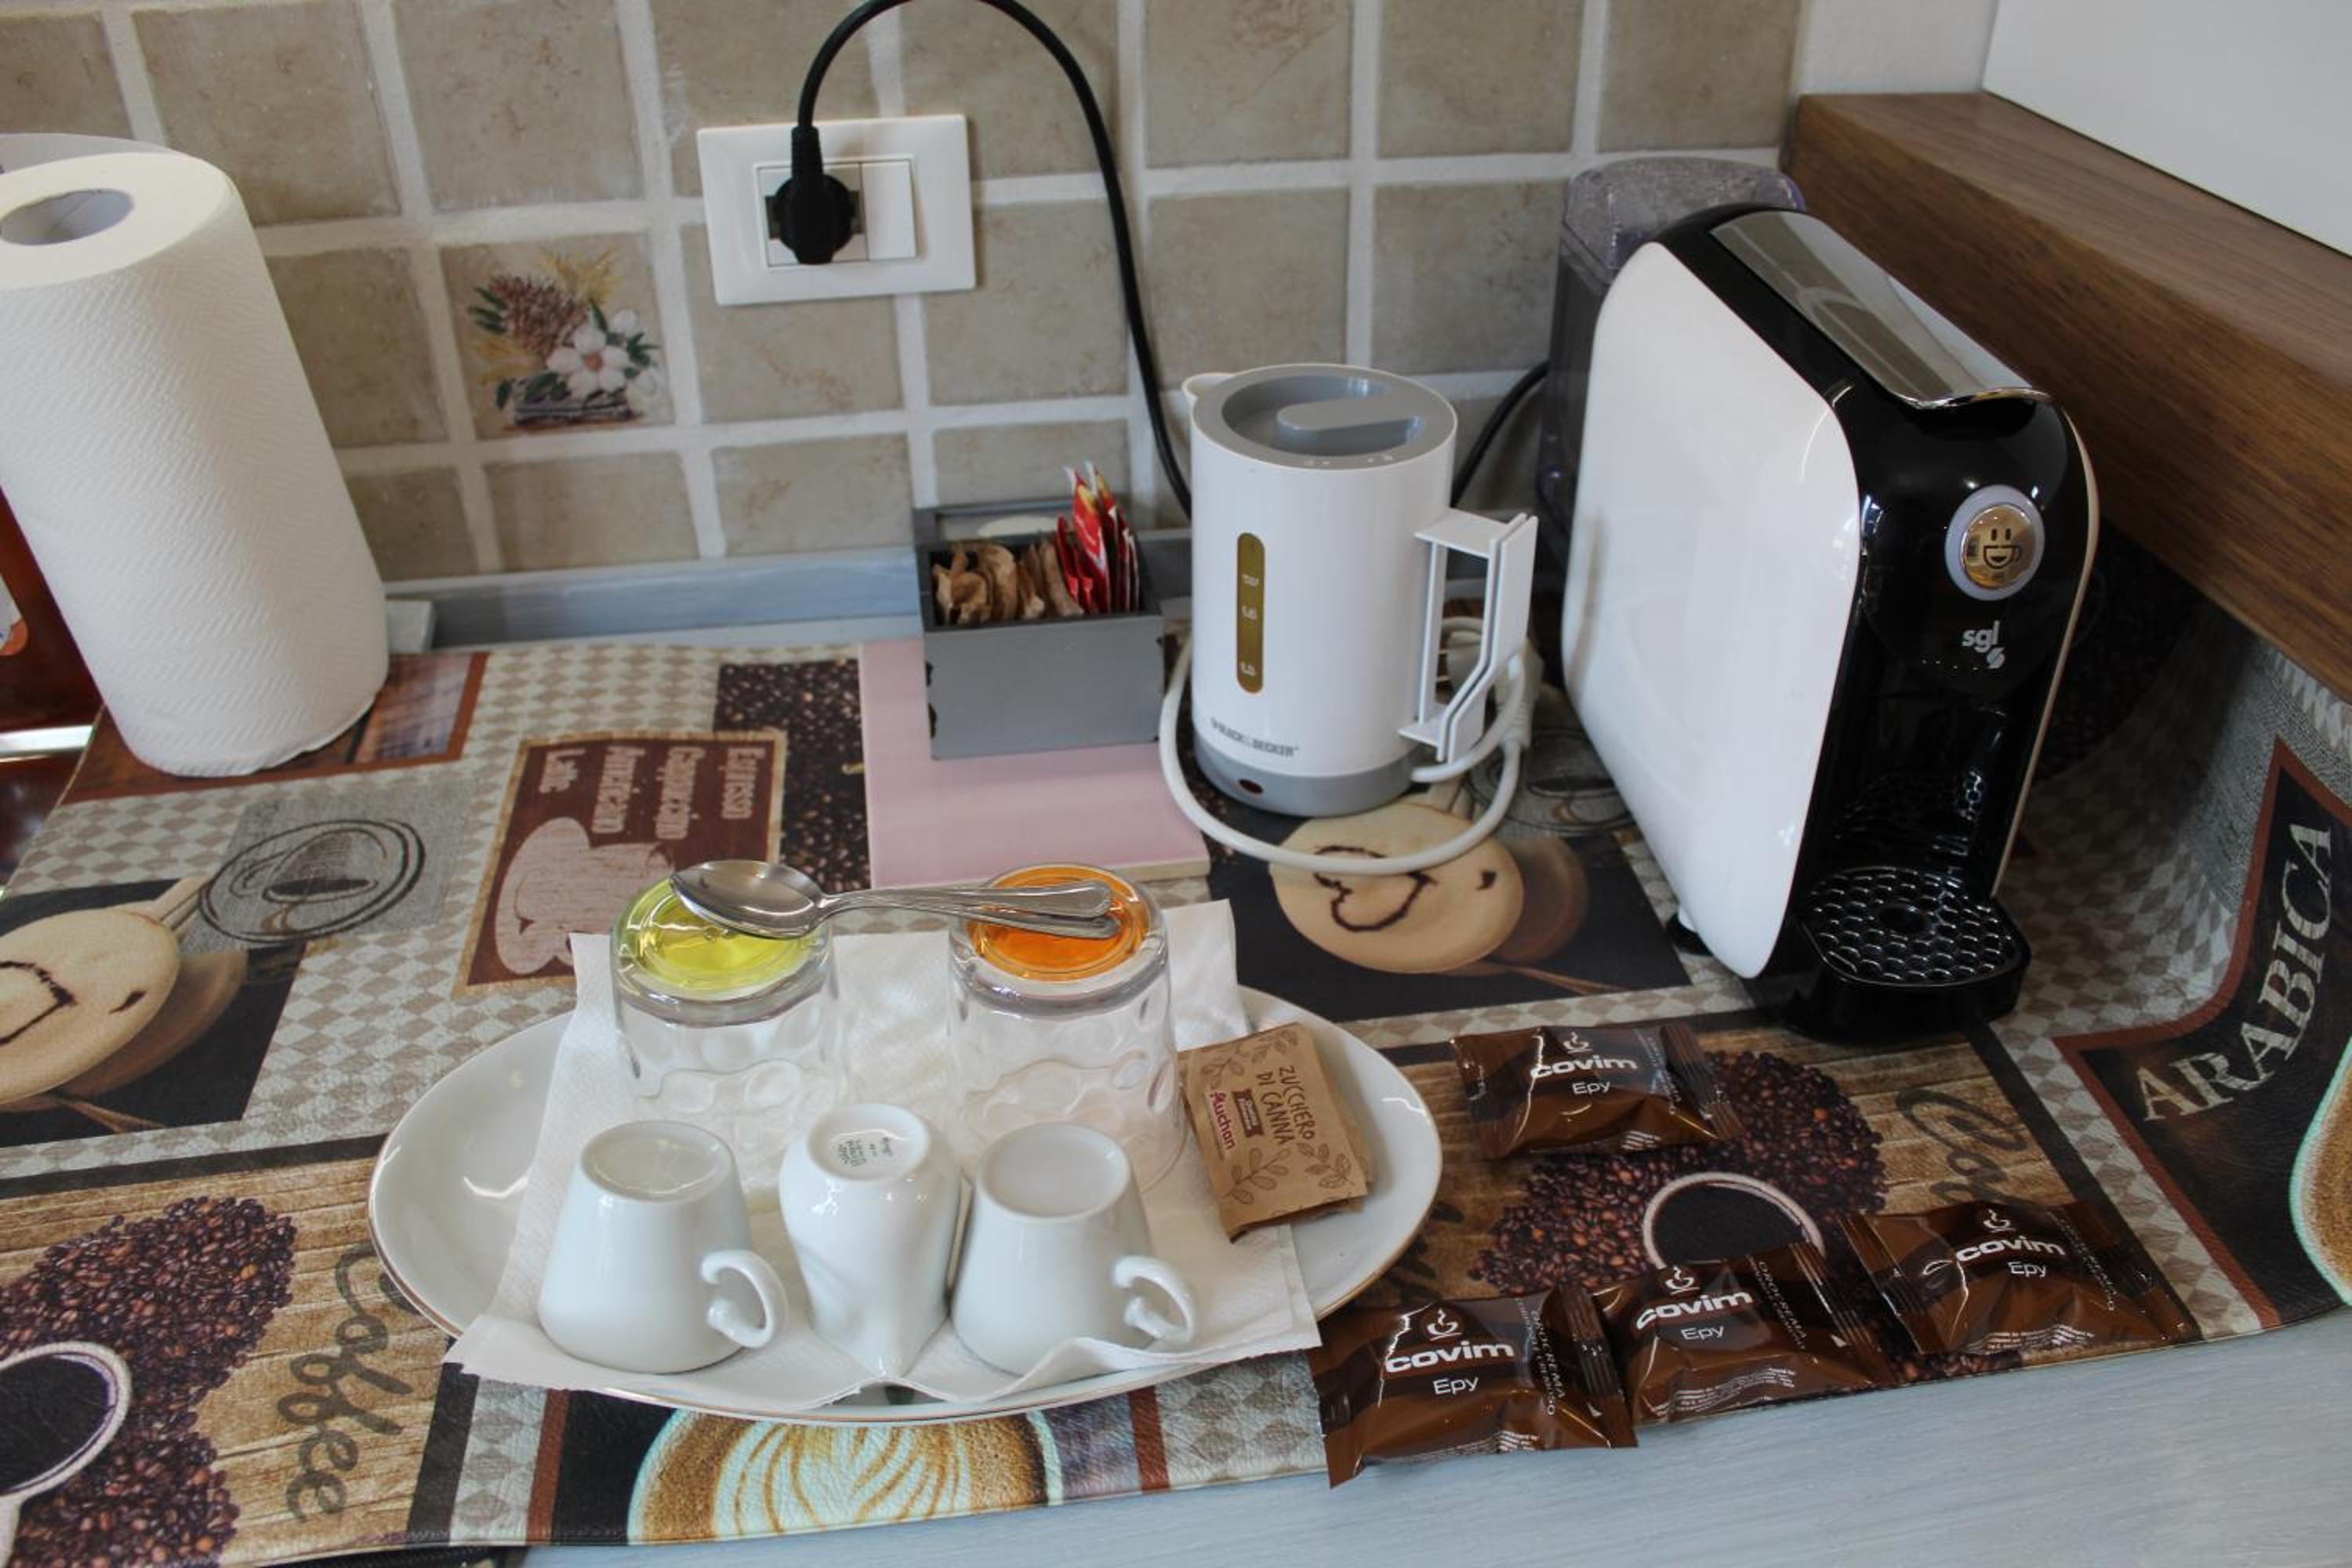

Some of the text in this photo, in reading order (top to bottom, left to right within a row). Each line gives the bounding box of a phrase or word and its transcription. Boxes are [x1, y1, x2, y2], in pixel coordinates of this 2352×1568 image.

[1962, 619, 2000, 653] sgl
[2136, 823, 2332, 1121] ARABICA
[1530, 1054, 1639, 1079] covim
[1279, 1065, 1316, 1140] ZUCCHERO
[1572, 1081, 1610, 1094] Epy
[1210, 1091, 1236, 1150] Auchan
[1256, 1071, 1294, 1145] DI CANNA
[1956, 1235, 2067, 1261] covim
[2008, 1261, 2047, 1277] Epy
[1636, 1291, 1754, 1330] covim
[1681, 1326, 1725, 1341] Epy
[1385, 1340, 1516, 1373] covim
[1432, 1377, 1479, 1396] Epy
